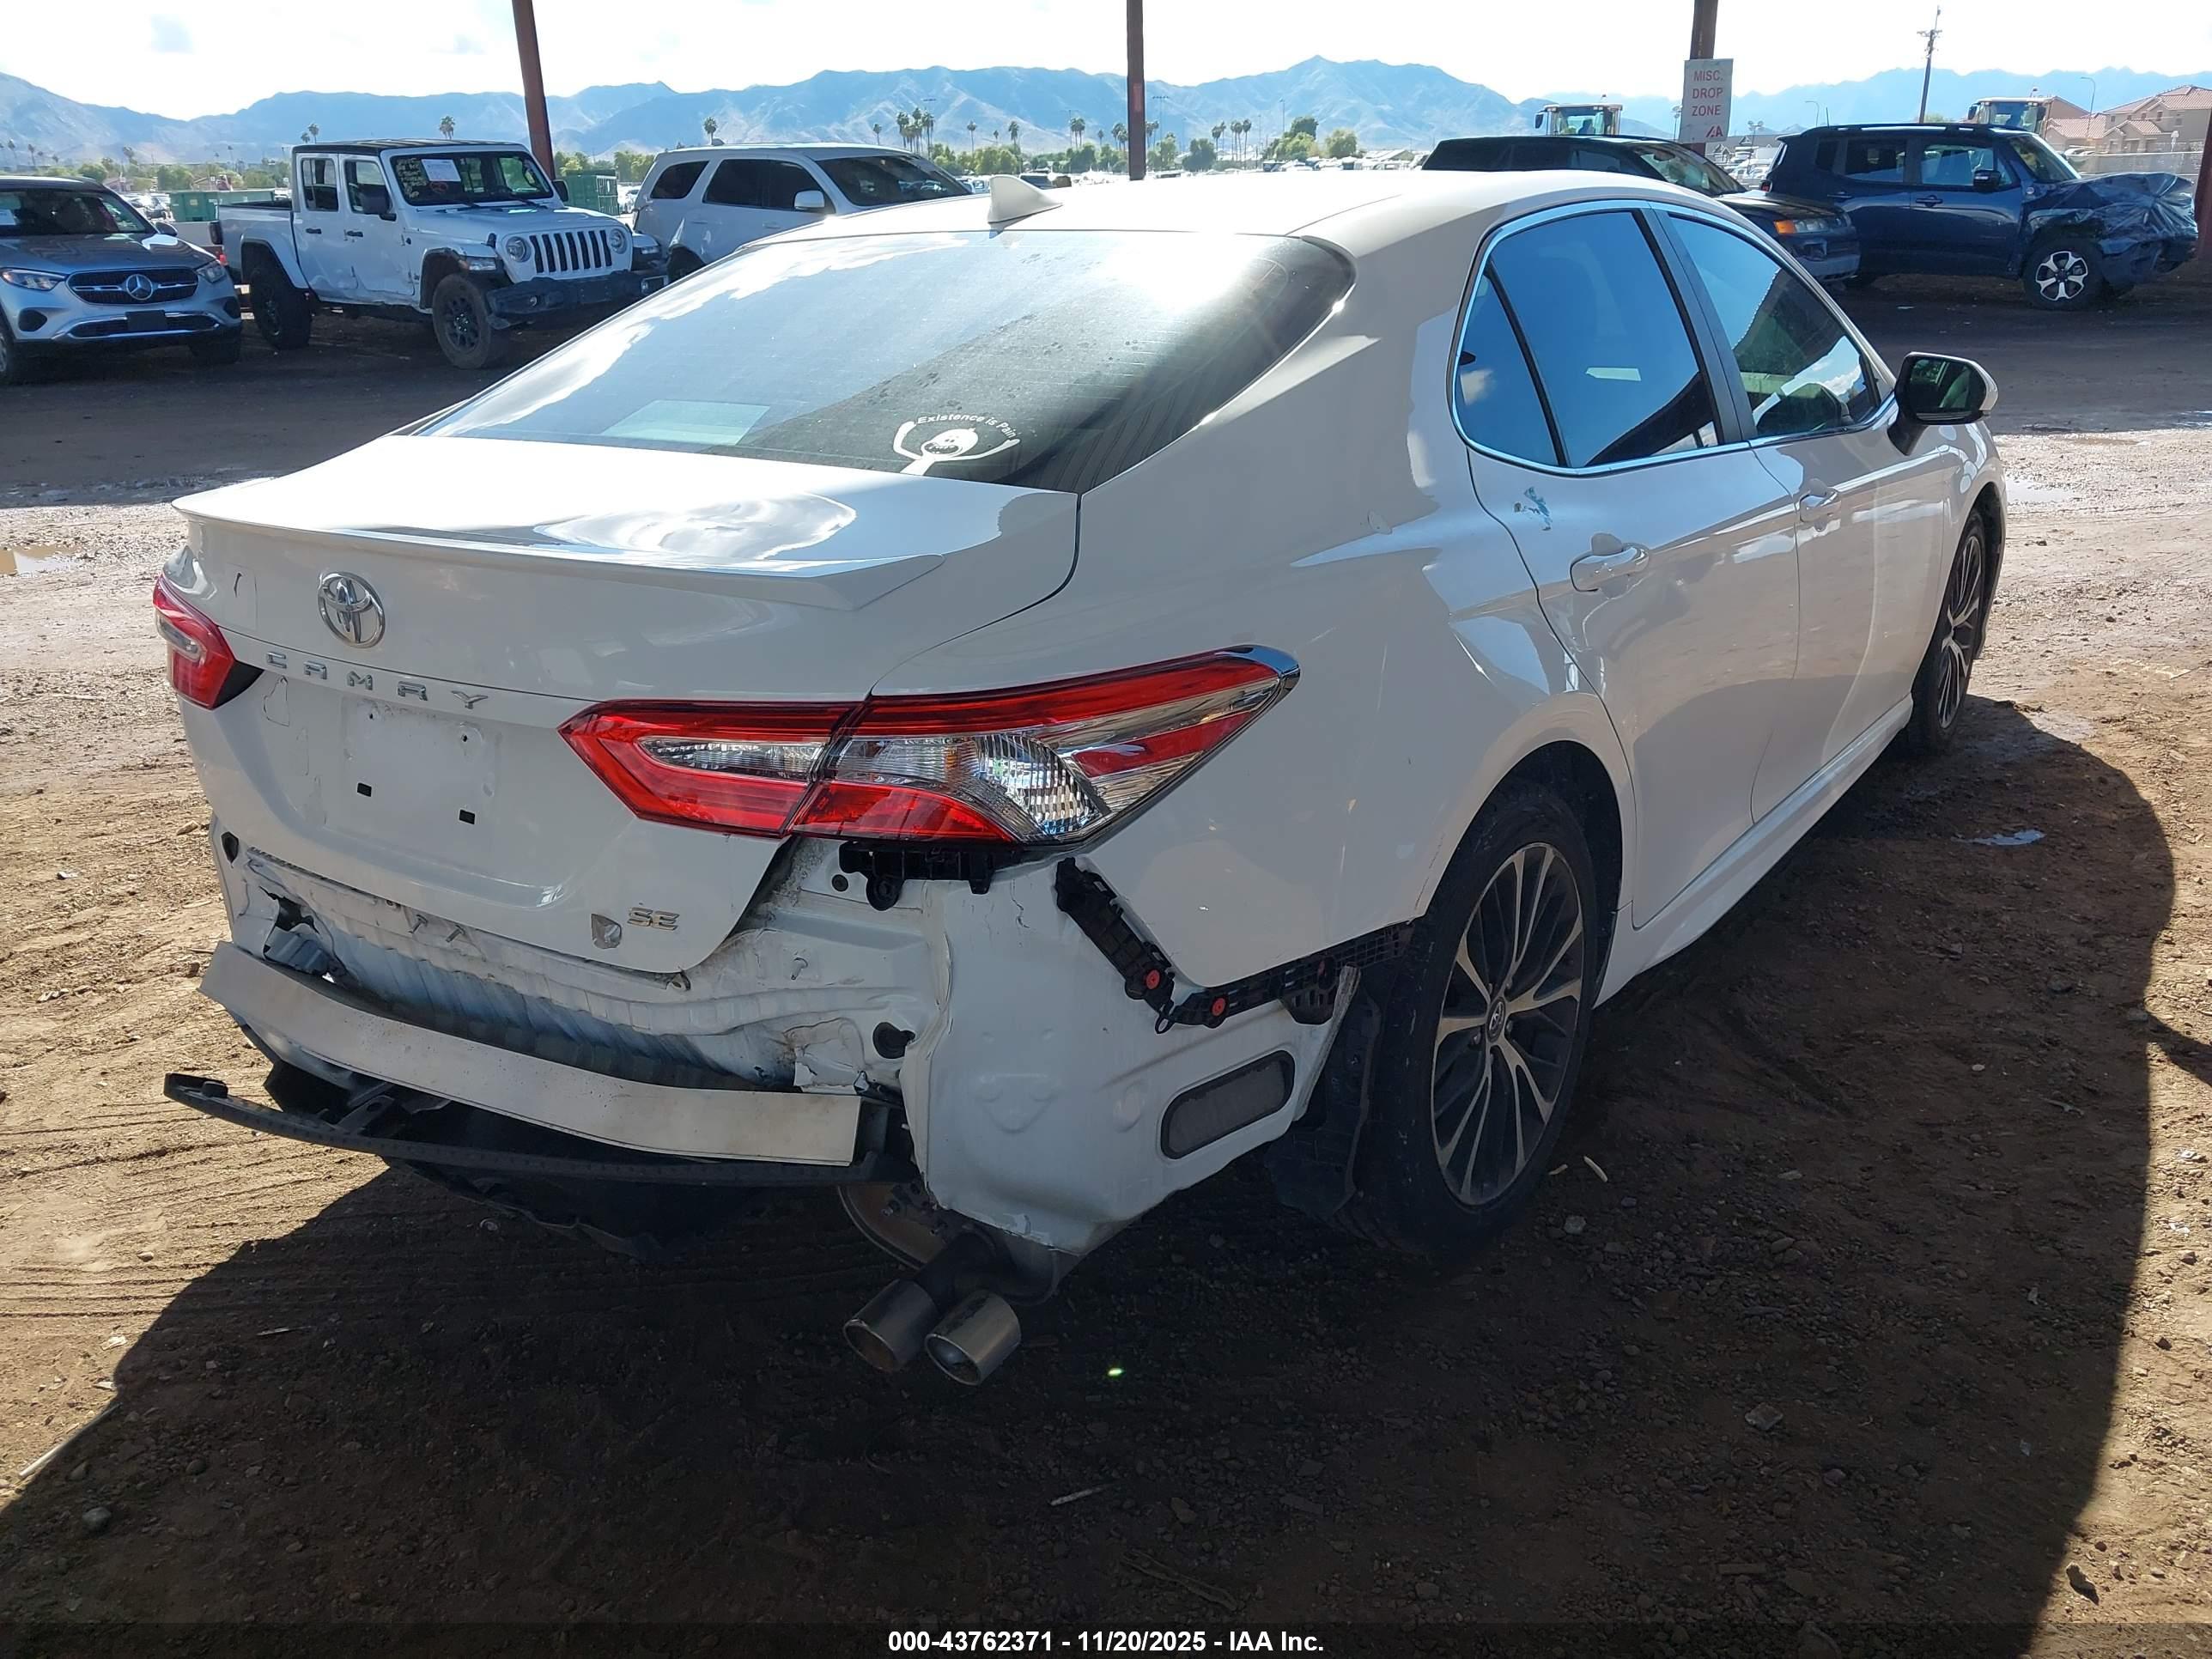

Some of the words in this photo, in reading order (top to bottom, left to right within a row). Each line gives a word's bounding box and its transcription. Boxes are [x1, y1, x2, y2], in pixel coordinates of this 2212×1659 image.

[1693, 70, 1724, 82] MISC.
[1692, 88, 1723, 100] DROP
[1692, 105, 1722, 117] ZONE
[917, 414, 986, 424] Existence
[985, 416, 998, 427] is
[996, 422, 1017, 439] Pain
[265, 650, 489, 710] CAMRY
[626, 906, 680, 932] SE
